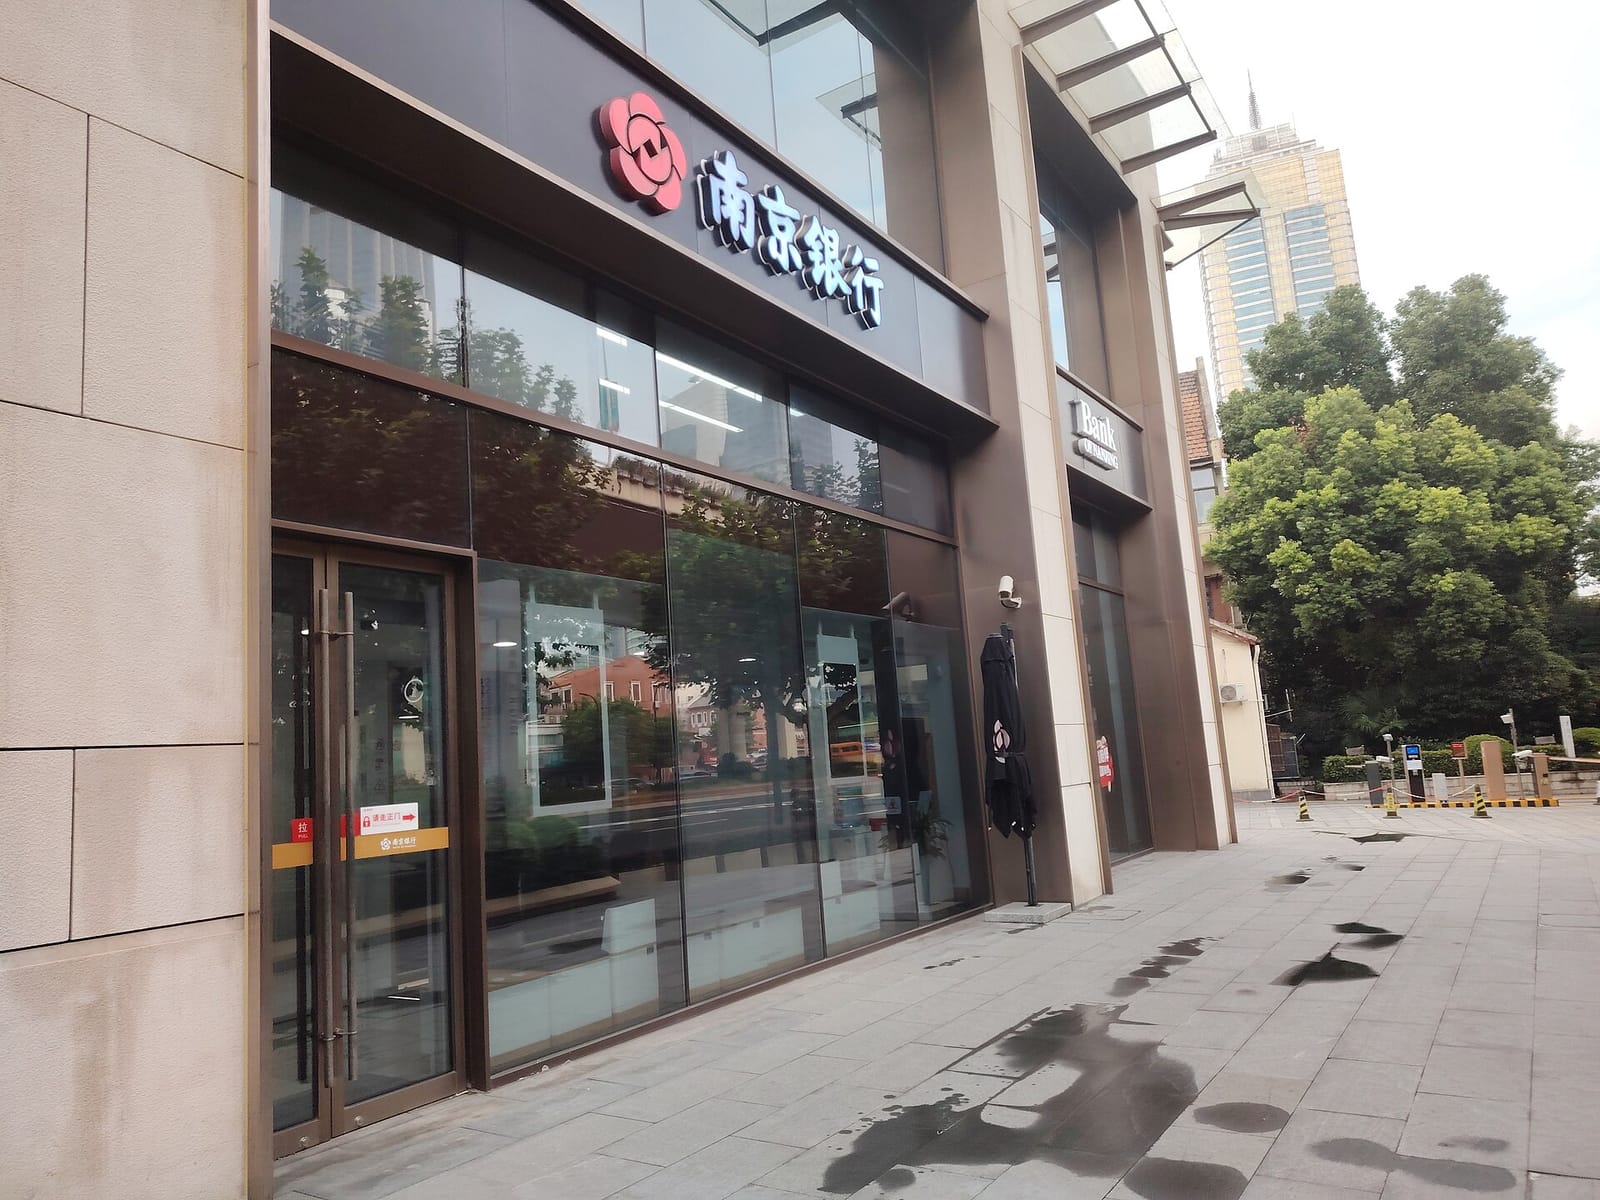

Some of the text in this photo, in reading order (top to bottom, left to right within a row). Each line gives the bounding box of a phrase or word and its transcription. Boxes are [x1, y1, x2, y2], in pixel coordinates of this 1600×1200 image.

[699, 150, 884, 329] 南京银行
[1080, 399, 1117, 453] Bank
[298, 822, 308, 833] 拉
[373, 812, 401, 823] 请走正门
